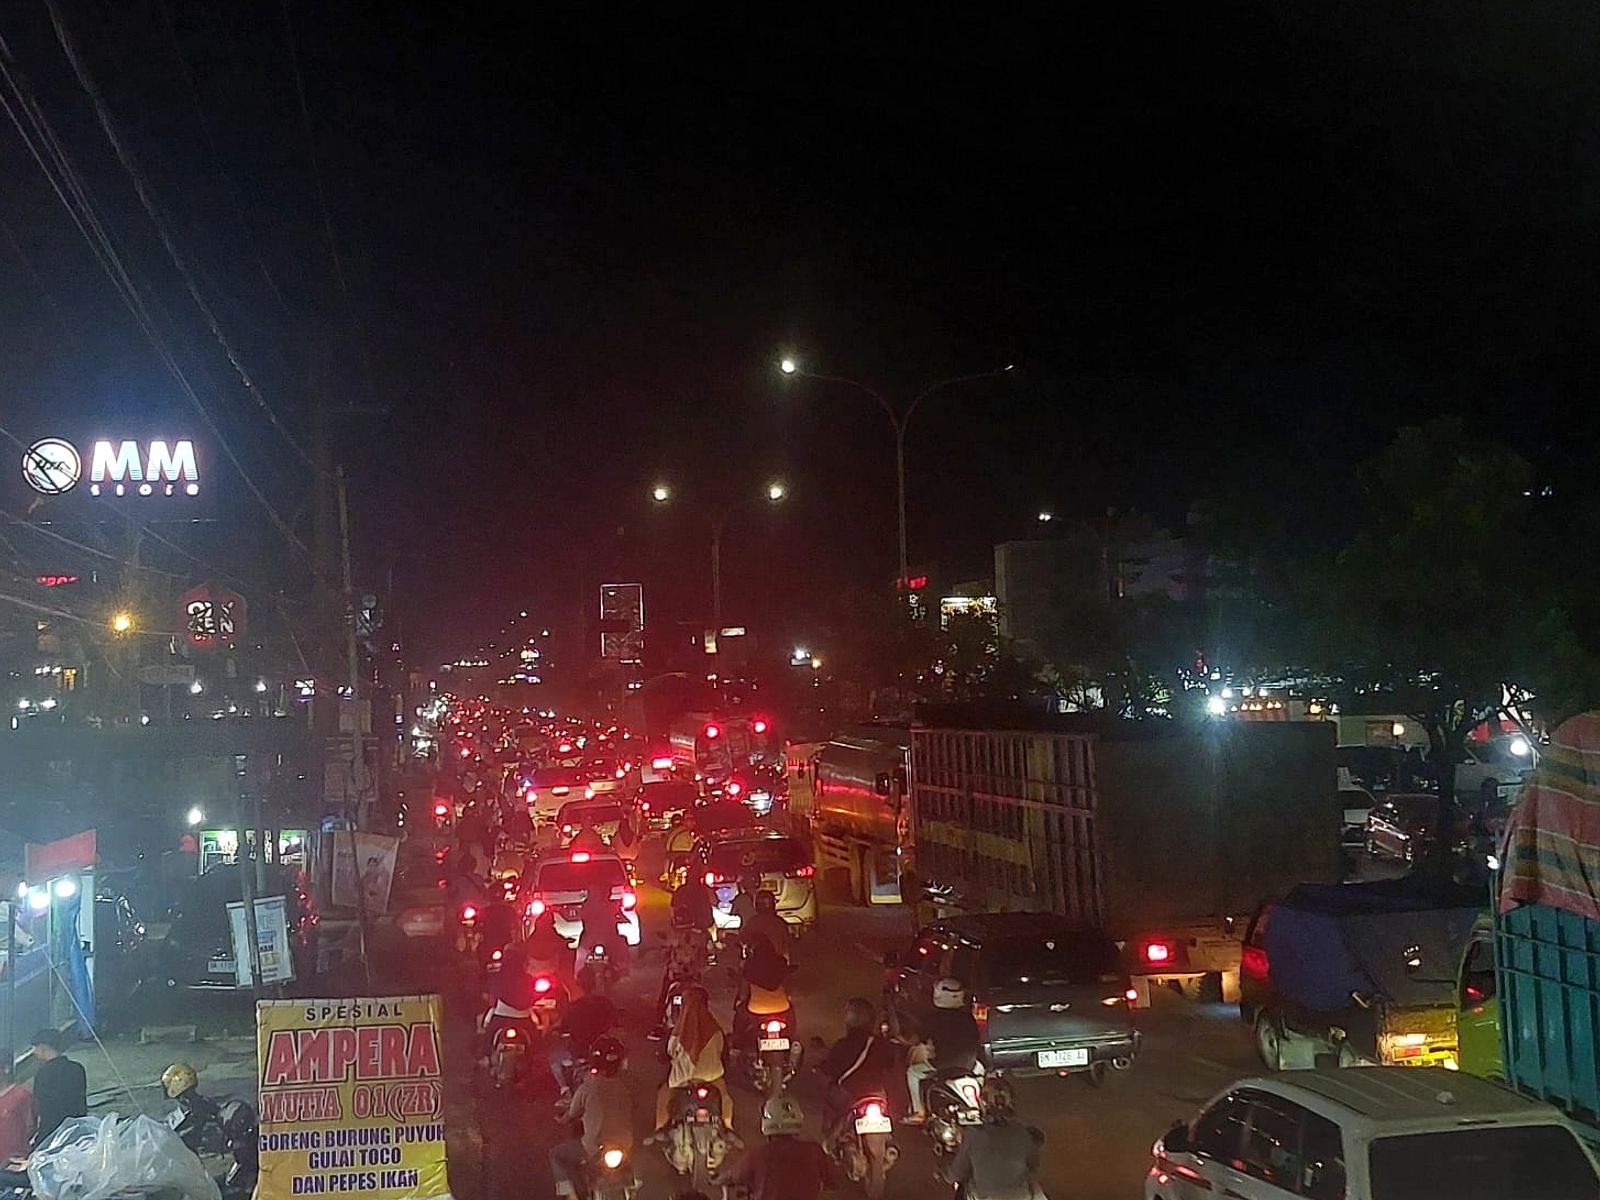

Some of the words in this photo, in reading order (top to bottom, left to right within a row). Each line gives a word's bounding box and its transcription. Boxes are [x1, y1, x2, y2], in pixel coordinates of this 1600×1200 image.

[91, 440, 199, 481] MM
[306, 1004, 402, 1020] SPESIAL
[264, 1023, 440, 1086] AMPERA
[259, 1087, 343, 1123] MUTIA
[259, 1132, 320, 1151] GORENG
[325, 1128, 390, 1147] BURUNG
[394, 1124, 446, 1143] PUYUH
[309, 1151, 354, 1169] GULAI
[359, 1147, 401, 1165] TOCO
[292, 1175, 325, 1194] DAN
[328, 1174, 375, 1192] PEPES
[381, 1169, 418, 1188] IKAN
